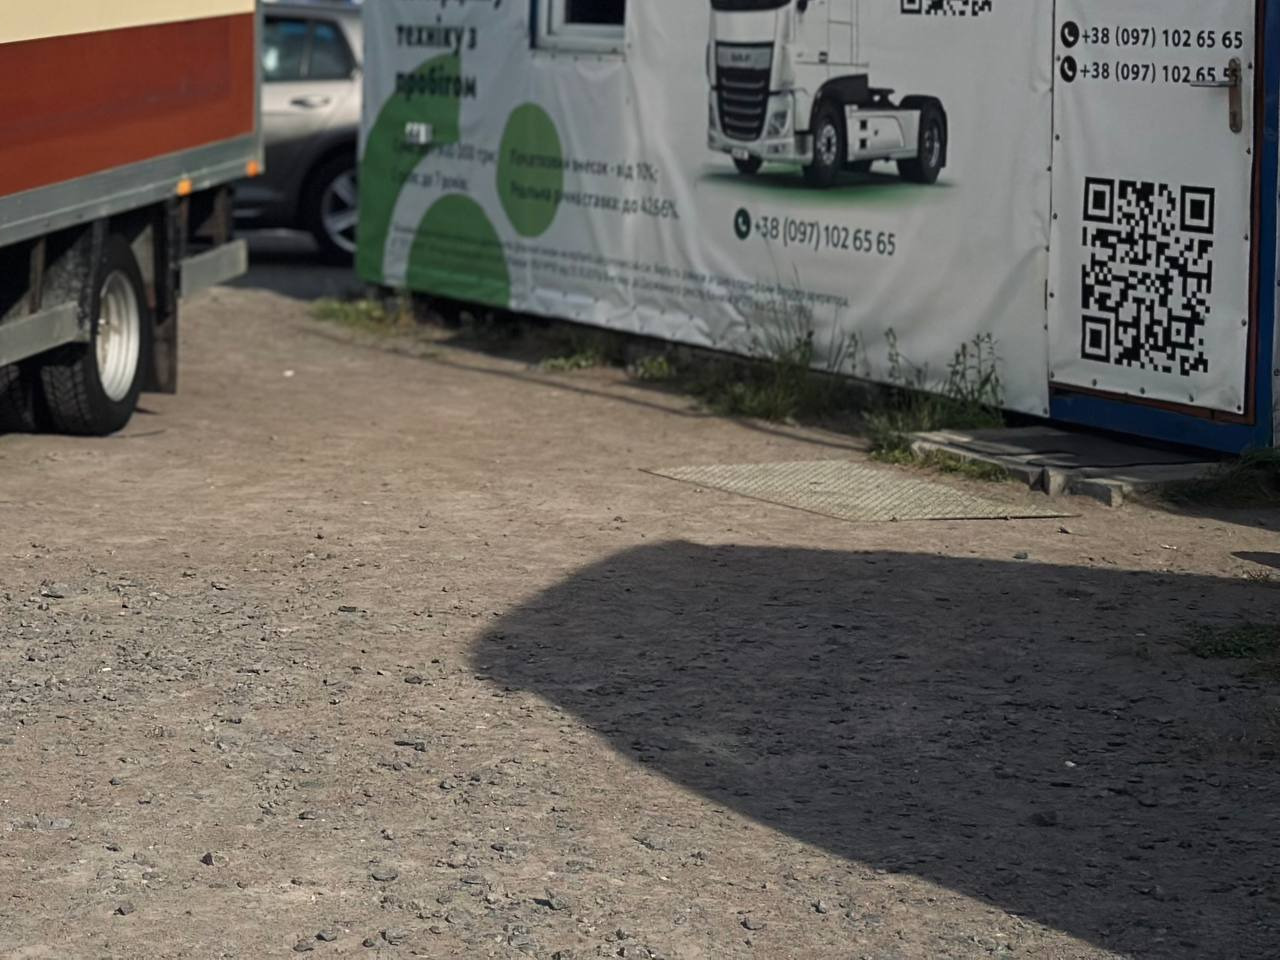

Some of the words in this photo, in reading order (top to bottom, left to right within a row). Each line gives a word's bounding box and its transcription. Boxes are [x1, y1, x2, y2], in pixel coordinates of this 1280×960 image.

[396, 14, 464, 56] техніку
[468, 26, 477, 50] з
[1081, 26, 1110, 45] +38
[1115, 26, 1156, 48] (097)
[1162, 29, 1192, 47] 102
[1196, 30, 1216, 49] 65
[1222, 30, 1243, 49] 65
[1080, 62, 1110, 79] +38
[1115, 62, 1156, 83] (097)
[1162, 66, 1191, 83] 102
[755, 216, 780, 240] +38
[783, 217, 821, 252] (097)
[824, 224, 850, 251] 102
[852, 228, 873, 254] 65
[876, 231, 897, 257] 65
